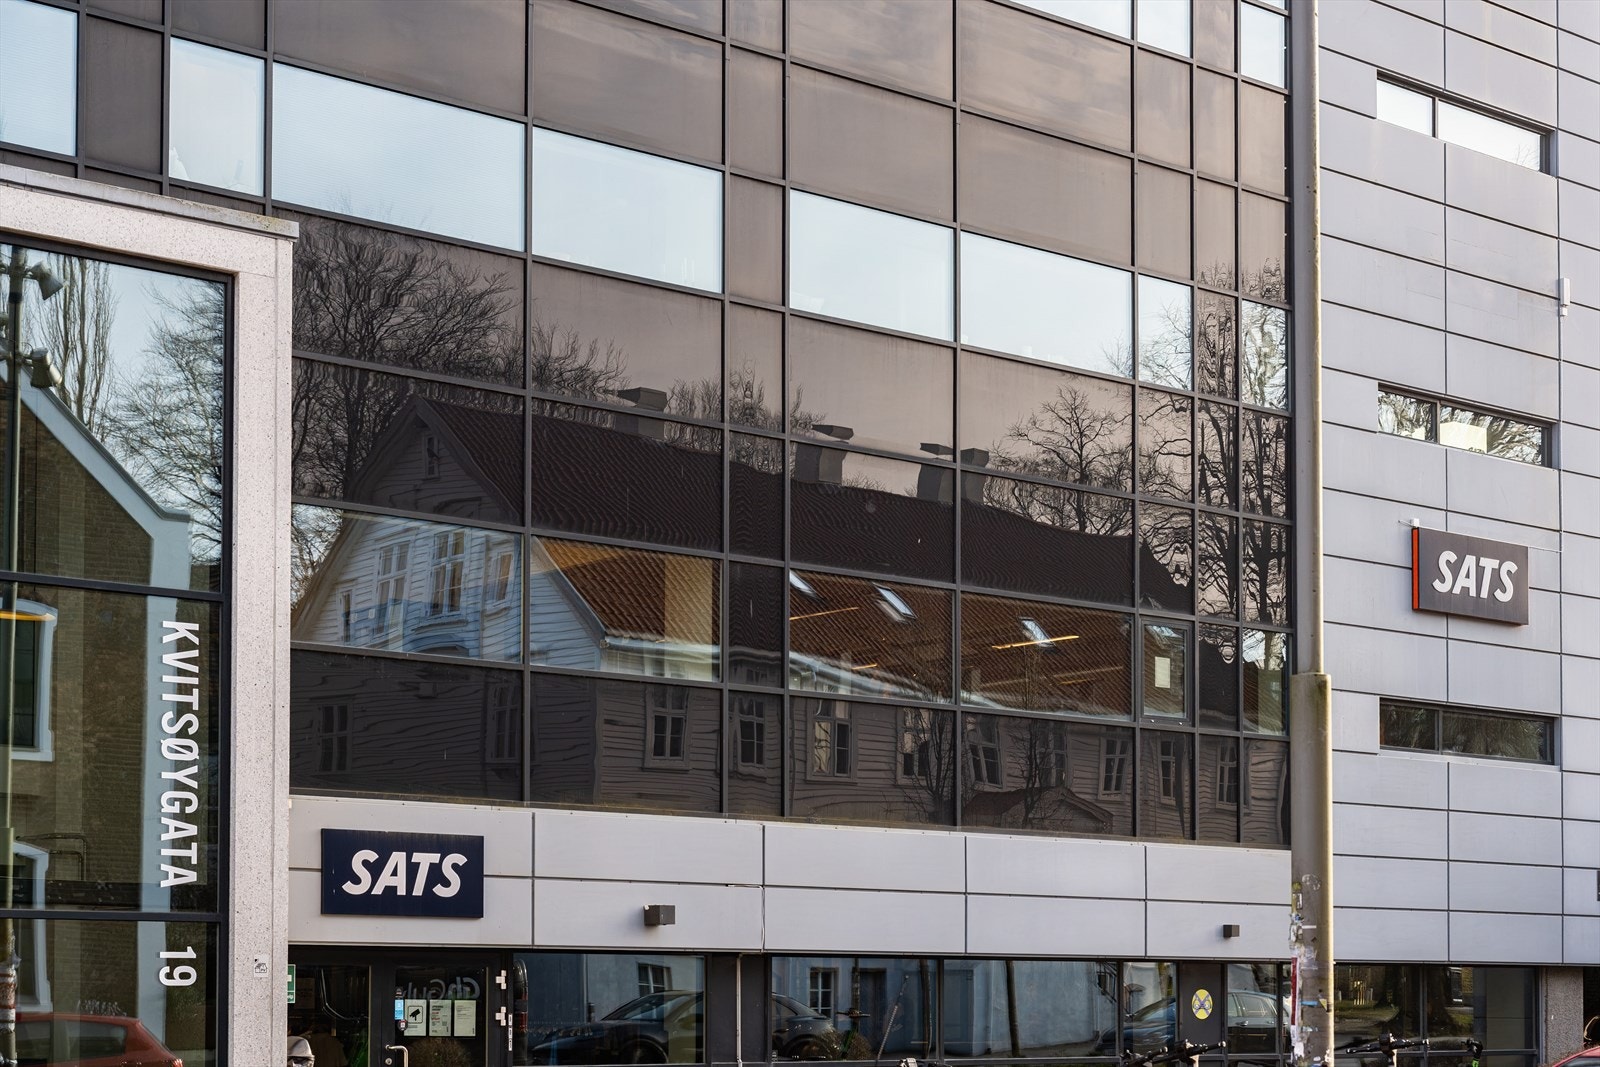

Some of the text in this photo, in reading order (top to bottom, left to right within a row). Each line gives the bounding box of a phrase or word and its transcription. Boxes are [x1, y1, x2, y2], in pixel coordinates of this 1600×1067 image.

[1432, 551, 1518, 602] SATS
[159, 620, 199, 986] KVITSØYGATA 19
[341, 849, 468, 898] SATS
